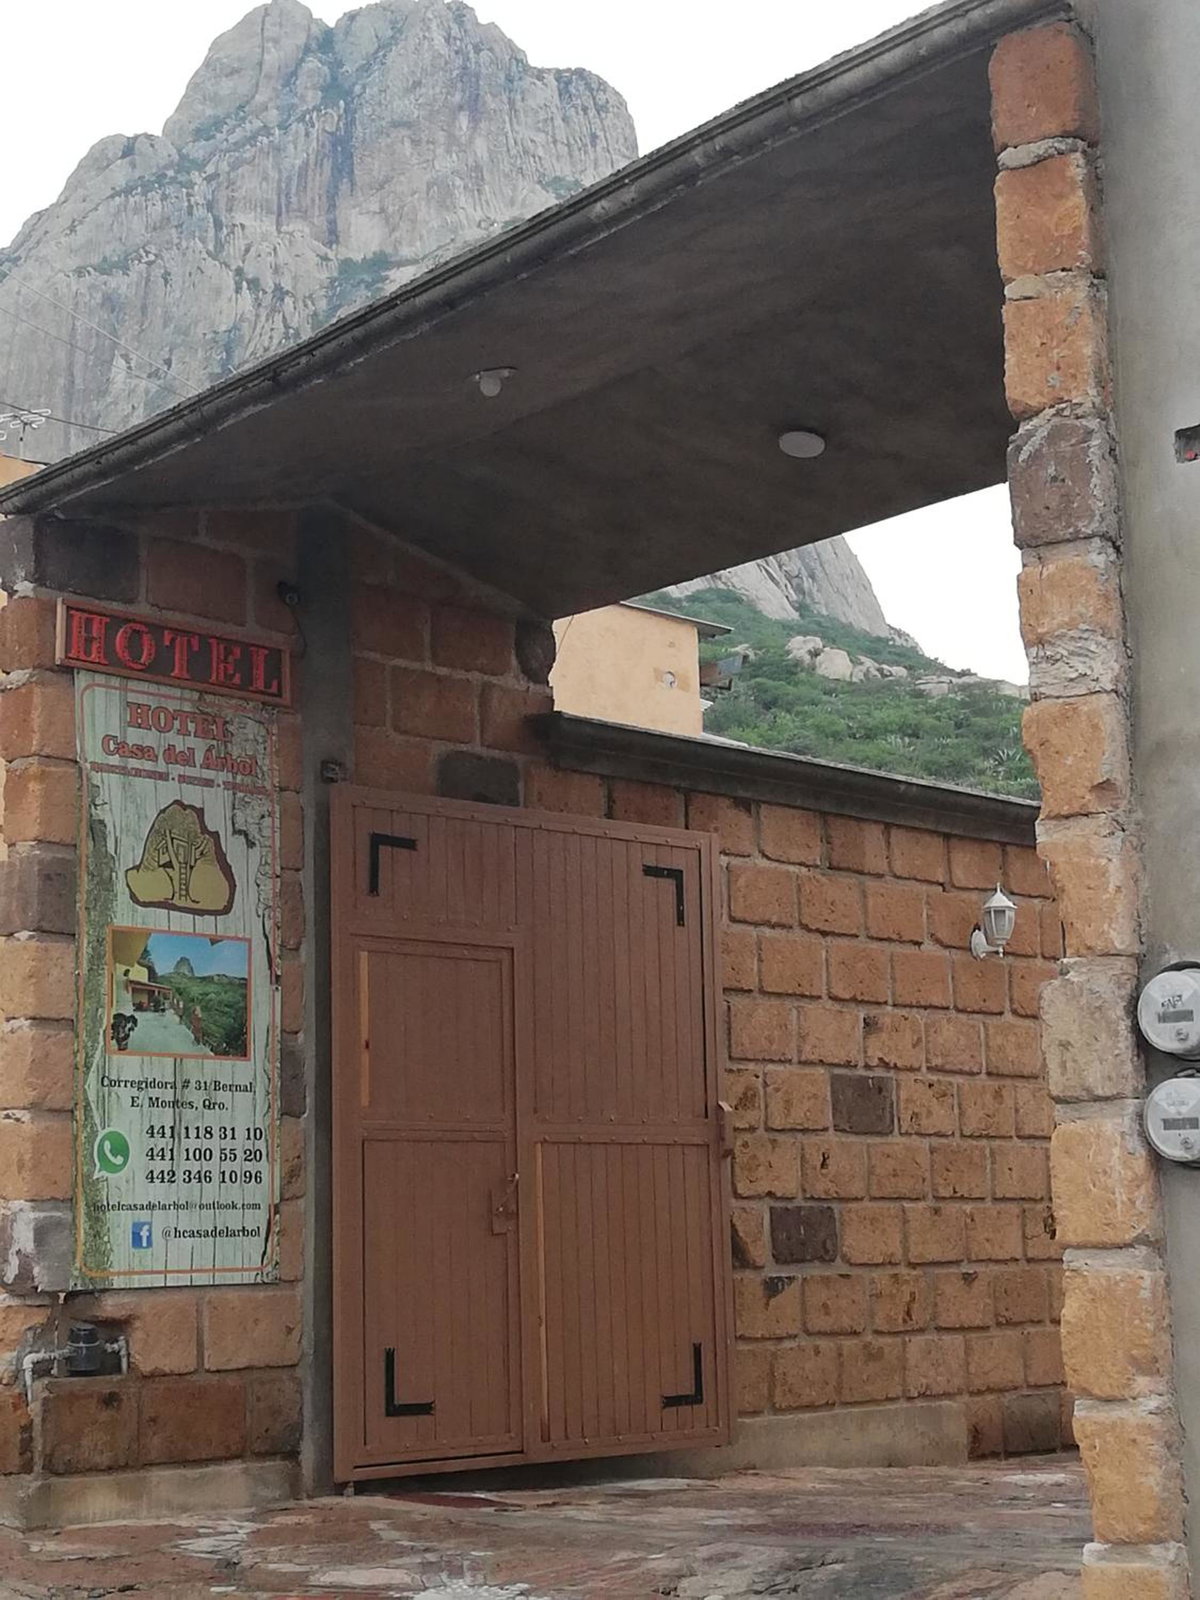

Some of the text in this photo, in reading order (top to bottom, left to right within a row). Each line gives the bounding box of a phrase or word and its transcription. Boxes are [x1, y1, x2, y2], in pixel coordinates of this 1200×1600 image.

[68, 609, 279, 694] HOTEL
[126, 701, 232, 743] HOTEL
[101, 734, 259, 778] Casa del Árbol
[100, 1075, 177, 1092] Corregidora
[181, 1078, 190, 1090] #
[194, 1079, 209, 1091] 31
[130, 1096, 229, 1112] E. Montes, Qro.
[145, 1125, 263, 1141] 441 118 31 10
[145, 1148, 263, 1163] 441 100 55 20
[145, 1170, 263, 1185] 442 346 10 96
[161, 1225, 261, 1240] @hcasadelarbol
